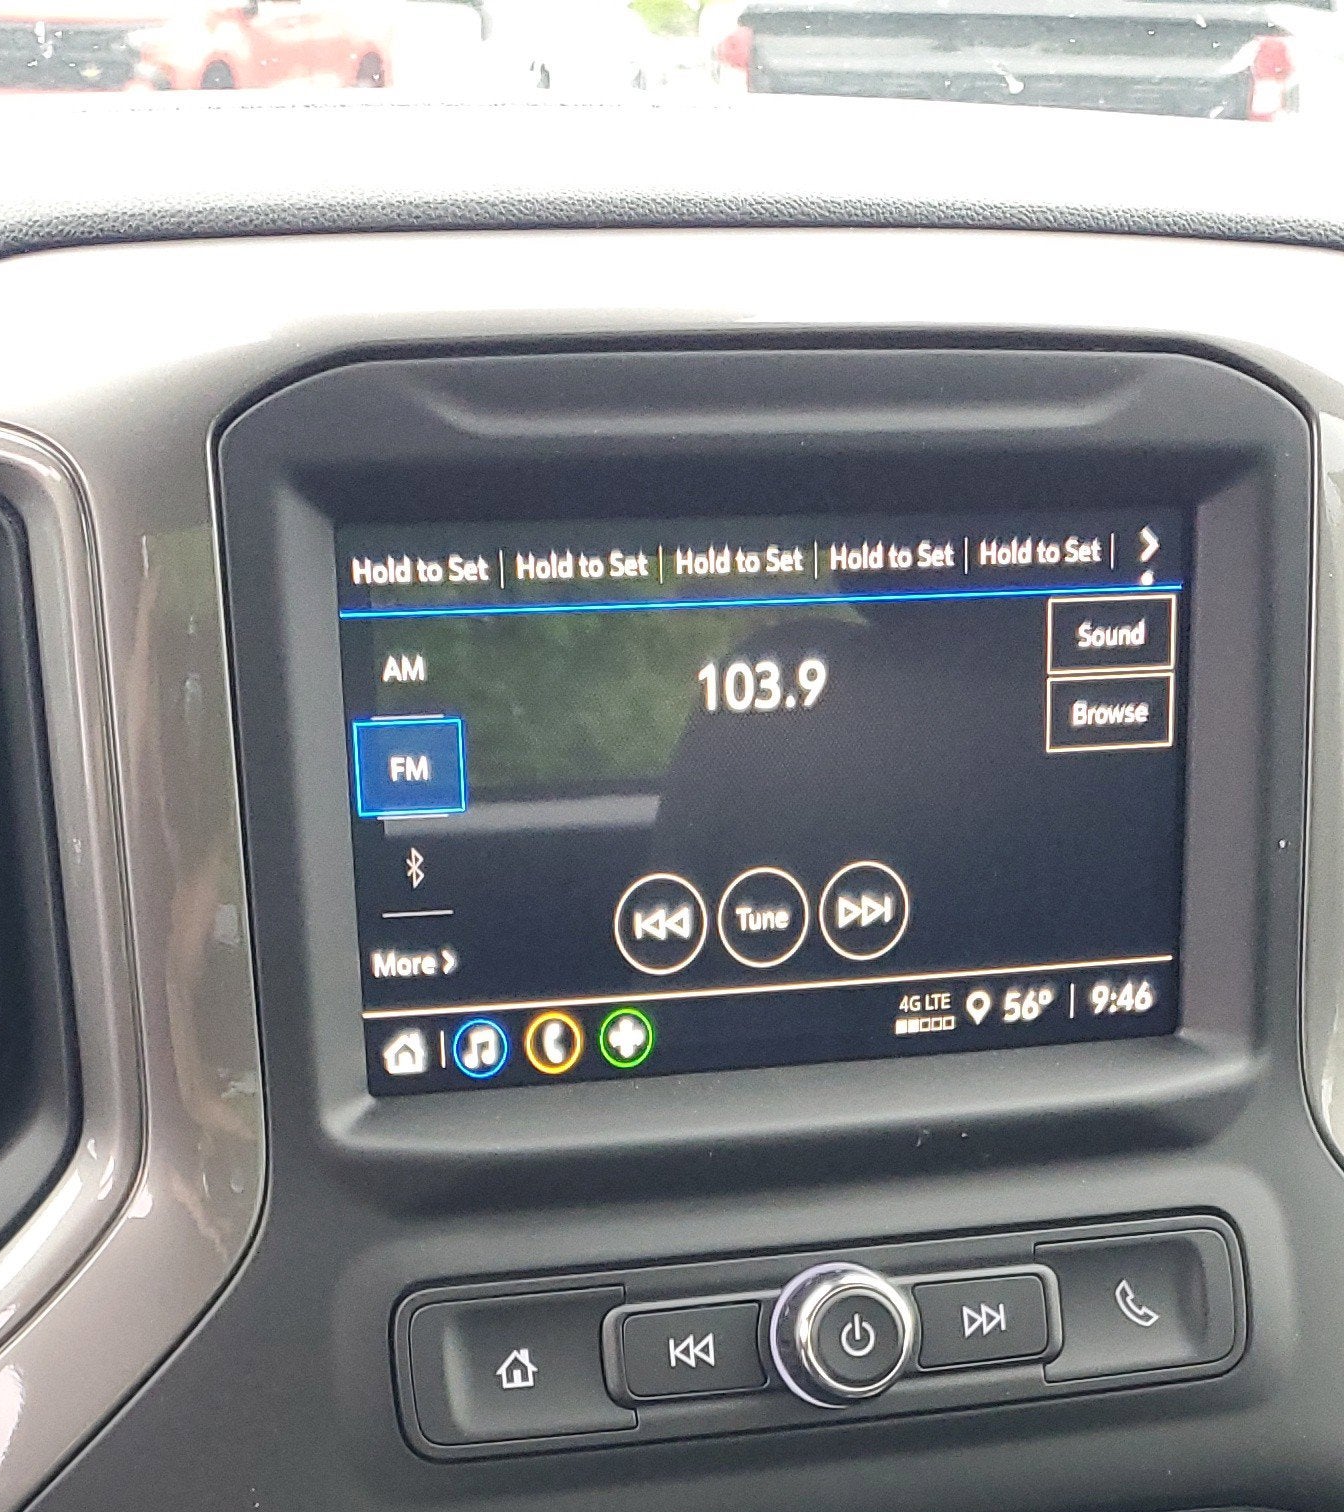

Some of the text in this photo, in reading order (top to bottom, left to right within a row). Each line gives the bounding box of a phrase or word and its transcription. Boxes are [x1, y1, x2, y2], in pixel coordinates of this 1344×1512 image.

[516, 548, 649, 580] Hold to Set
[675, 543, 803, 576] Hold to Set
[830, 539, 955, 571] Hold to Set
[979, 536, 1102, 566] Hold to Set
[351, 552, 489, 585] Hold to Set
[1077, 619, 1146, 648] Sound
[382, 655, 425, 683] AM
[698, 658, 826, 712] 103.9
[1072, 700, 1149, 727] Browse
[390, 755, 430, 782] FM
[735, 906, 790, 932] Tune
[372, 951, 436, 979] More
[899, 992, 951, 1013] 4G LTE
[1091, 981, 1154, 1014] 9:46
